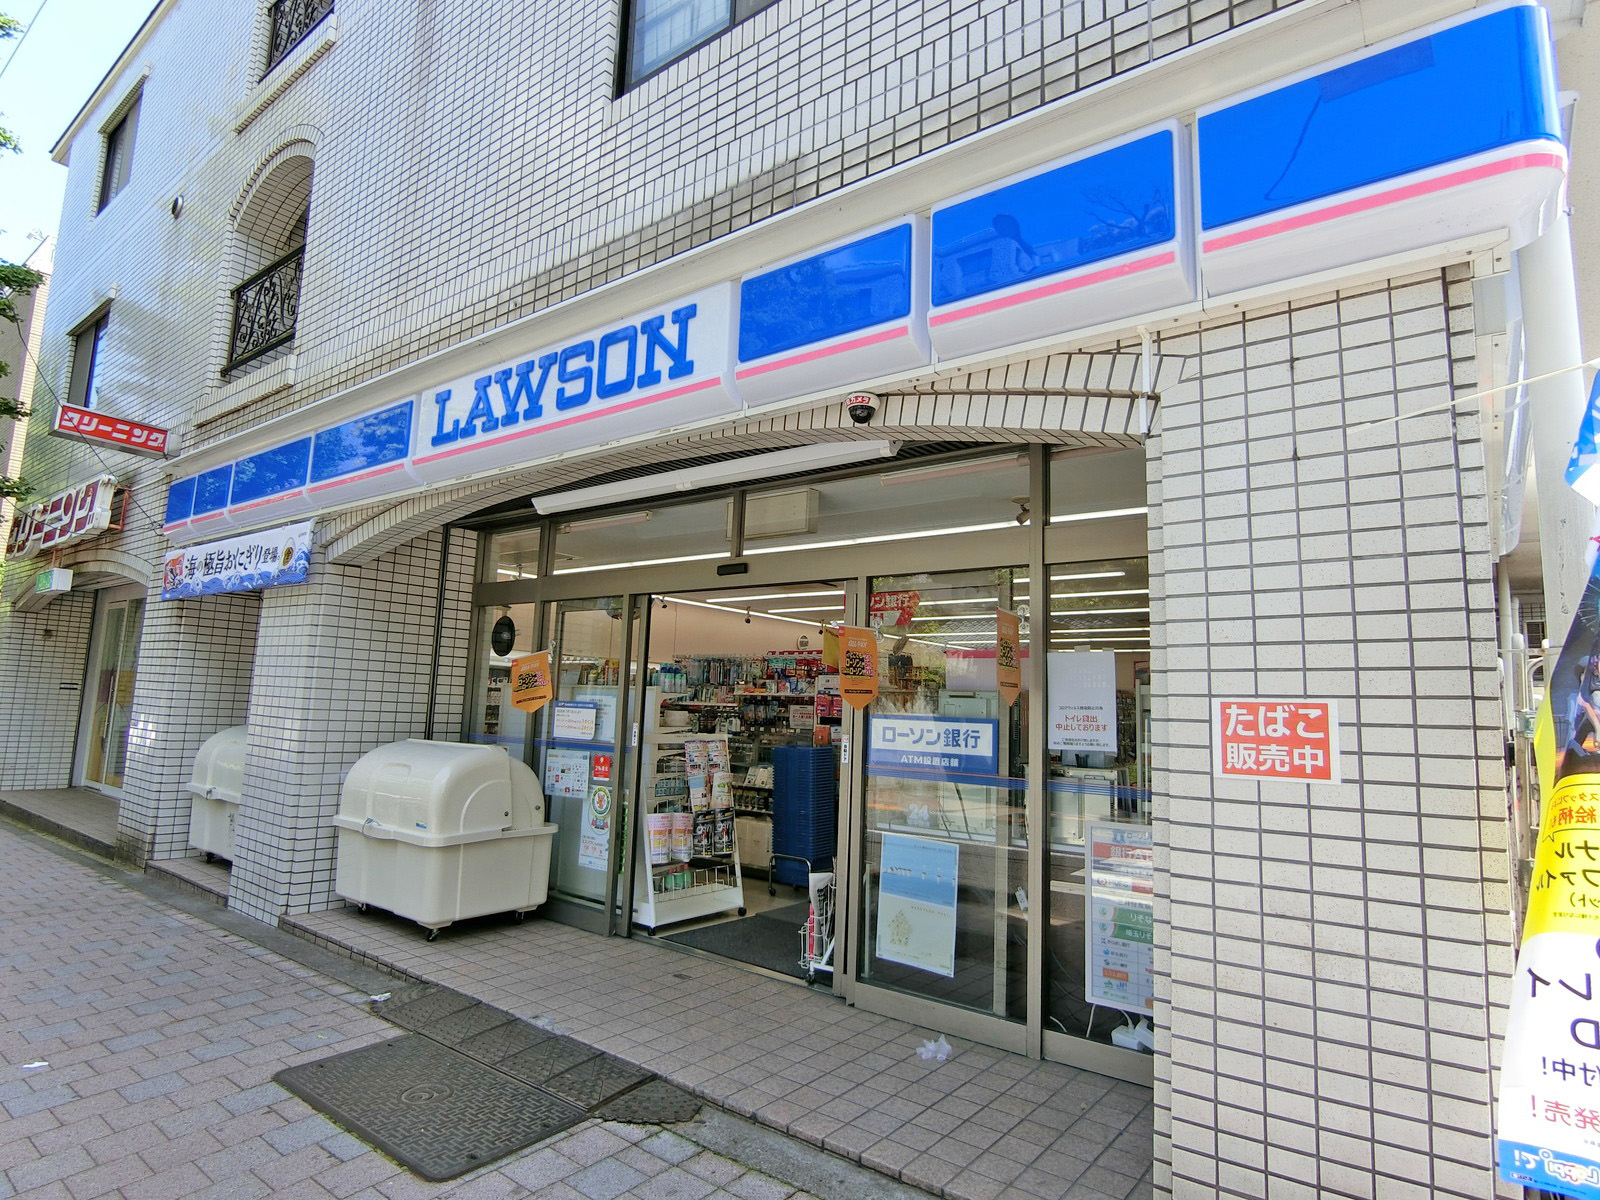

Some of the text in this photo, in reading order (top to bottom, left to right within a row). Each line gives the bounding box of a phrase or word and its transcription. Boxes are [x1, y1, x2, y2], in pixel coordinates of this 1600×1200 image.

[431, 303, 697, 447] LAWSON
[61, 411, 166, 447] クリーニング
[1055, 723, 1108, 732] 中止しております
[1225, 704, 1325, 738] たばこ
[882, 727, 981, 750] ローソン銀行
[901, 754, 959, 768] ATM設置店舗
[1225, 742, 1325, 774] 販売中
